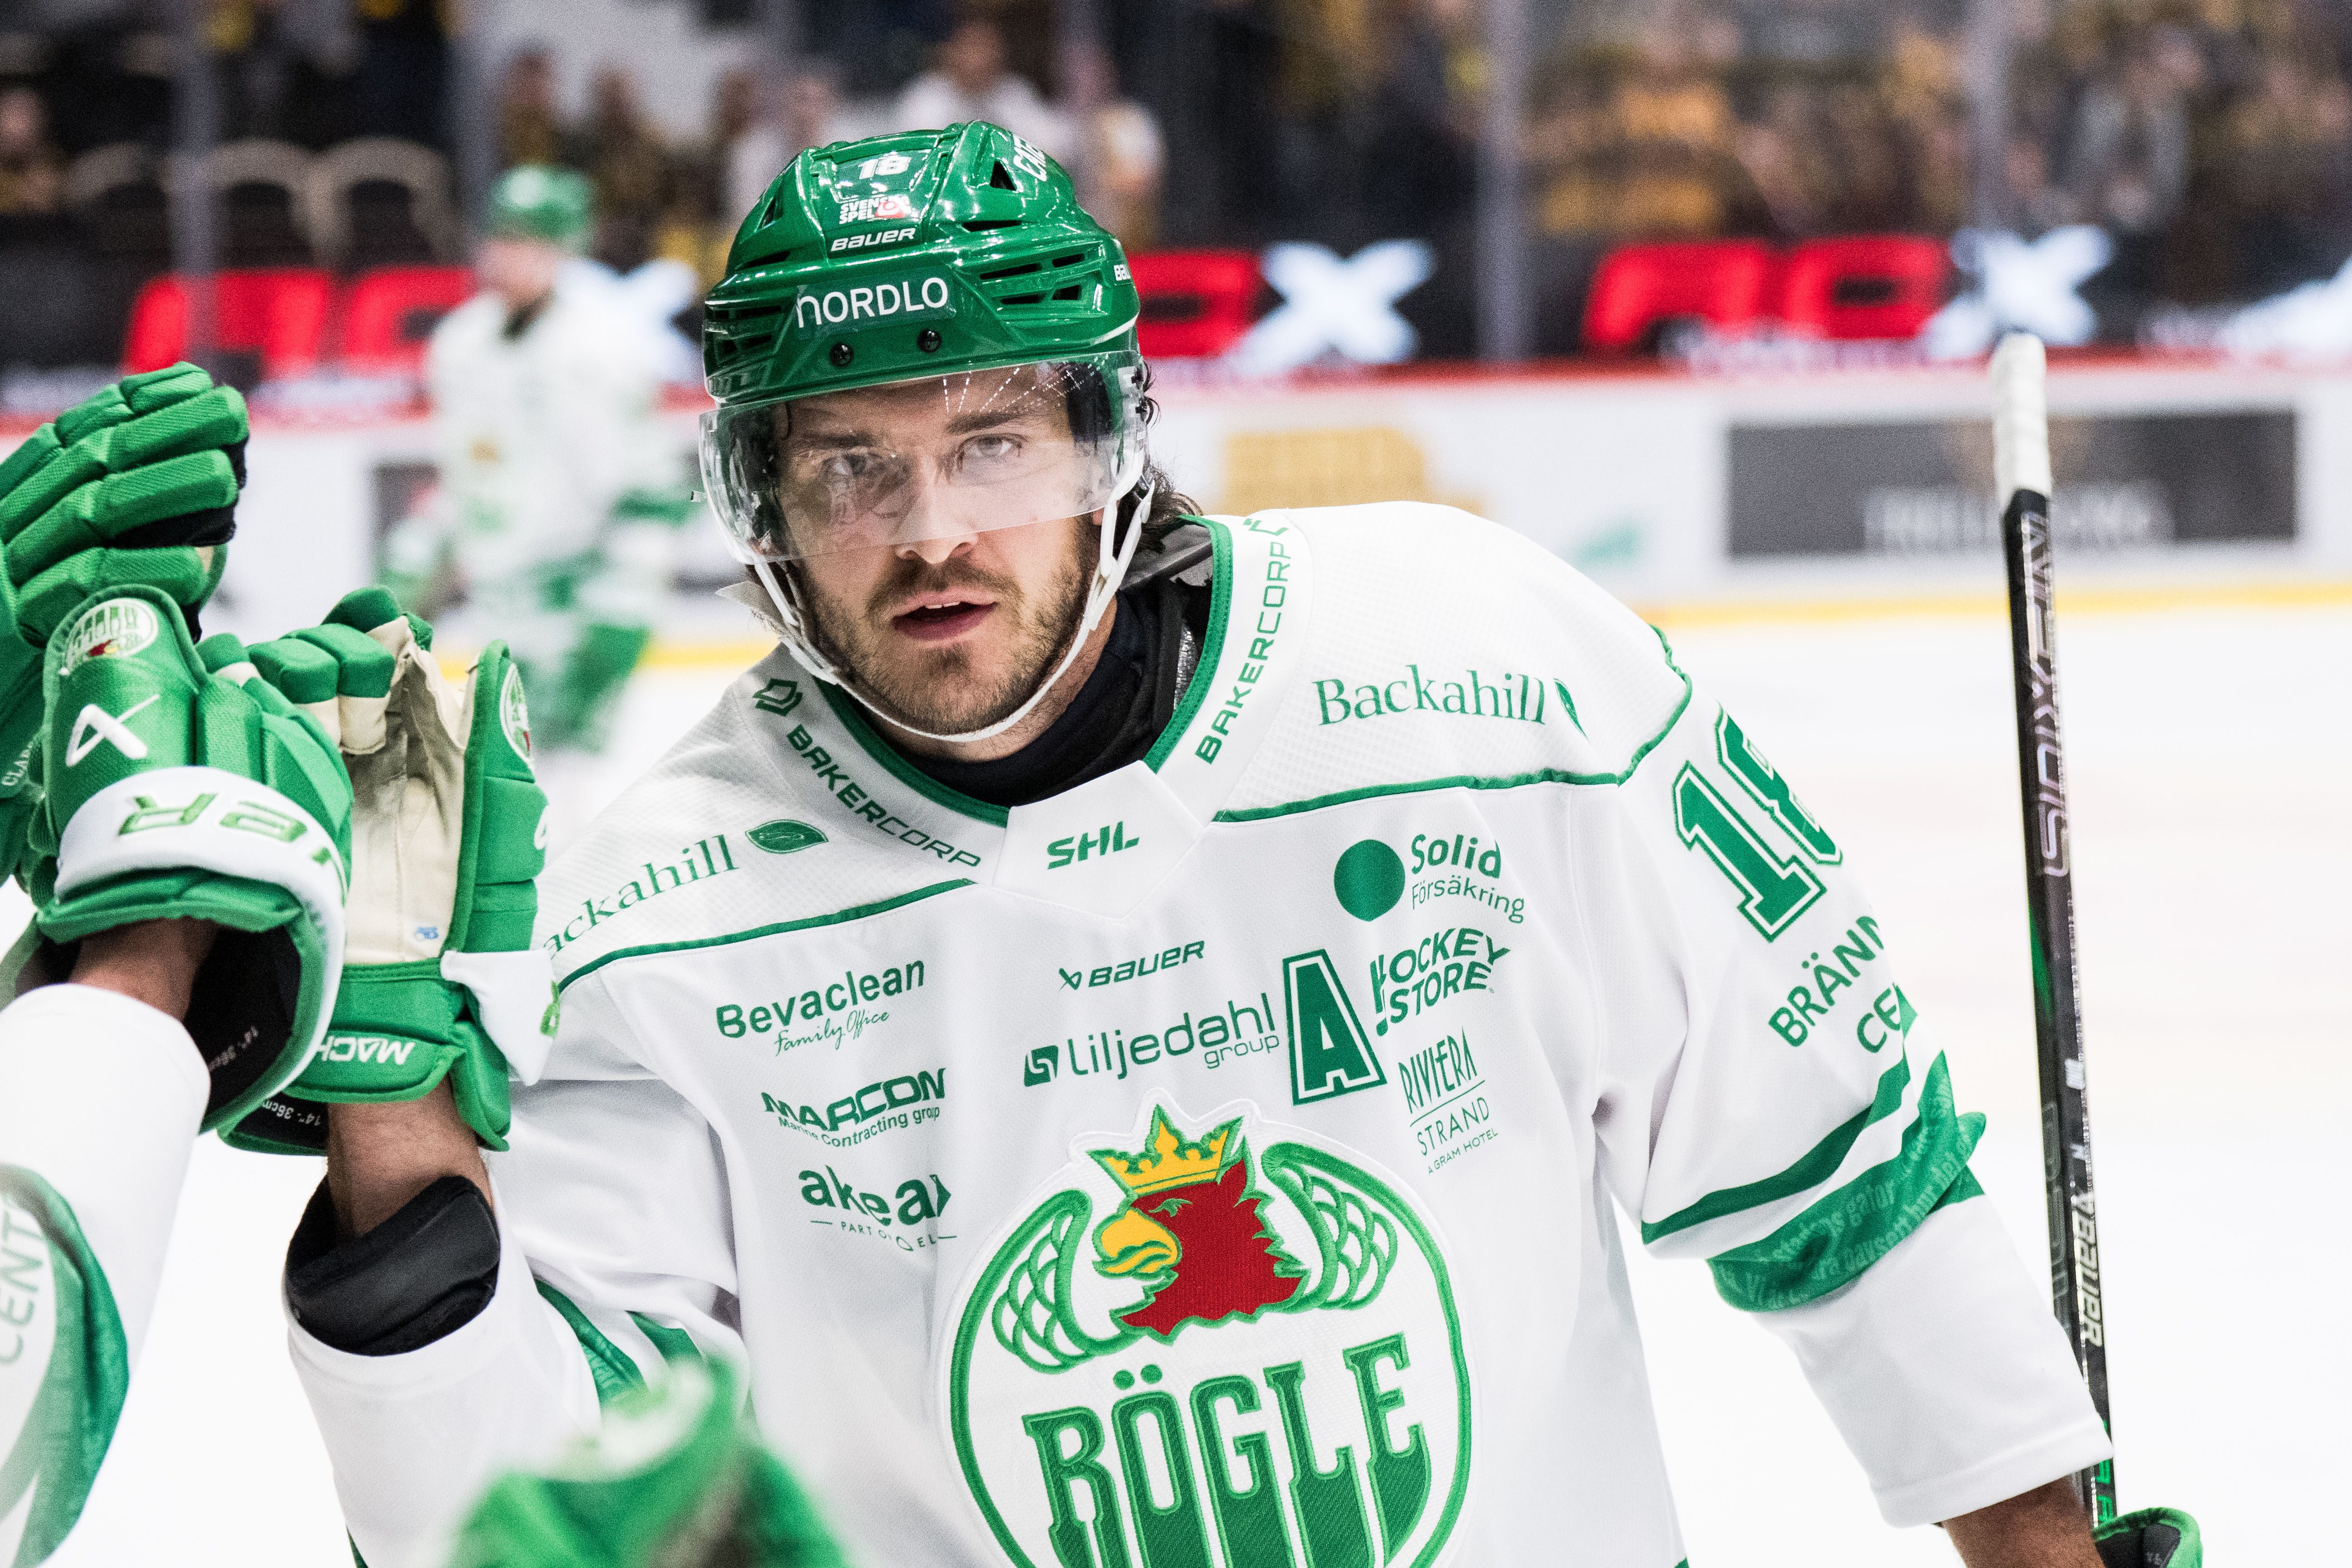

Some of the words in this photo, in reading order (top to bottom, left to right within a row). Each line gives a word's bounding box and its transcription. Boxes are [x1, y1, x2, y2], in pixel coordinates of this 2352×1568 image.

[858, 156, 912, 180] 18
[830, 228, 916, 252] BAUER
[839, 208, 875, 224] SPEL
[1195, 541, 1291, 765] BAKERCORP
[1311, 664, 1546, 726] Backahill
[786, 724, 981, 867] BAKERCORP
[1047, 820, 1140, 870] SHL
[1411, 834, 1502, 879] Solid
[543, 834, 740, 960] ackahill
[1412, 875, 1524, 924] Försäkring
[1088, 940, 1205, 988] BAUER
[1370, 927, 1511, 1014] HOCKEY
[1390, 961, 1492, 1024] STORE
[715, 960, 925, 1039] Bevaclean
[846, 1009, 890, 1040] Office
[1282, 948, 1388, 1107] A
[773, 1018, 845, 1057] Family
[1067, 993, 1275, 1080] Liljedahl
[1204, 1034, 1280, 1069] group
[1398, 1026, 1478, 1114] RIVIERA
[761, 1068, 946, 1132] MARCON
[821, 1112, 908, 1147] Contracting
[912, 1106, 940, 1124] group
[1417, 1097, 1489, 1156] STRAND
[1434, 1147, 1461, 1170] GRAM
[1463, 1127, 1498, 1152] HOTEL
[1021, 1331, 1432, 1568] RÖGLE
